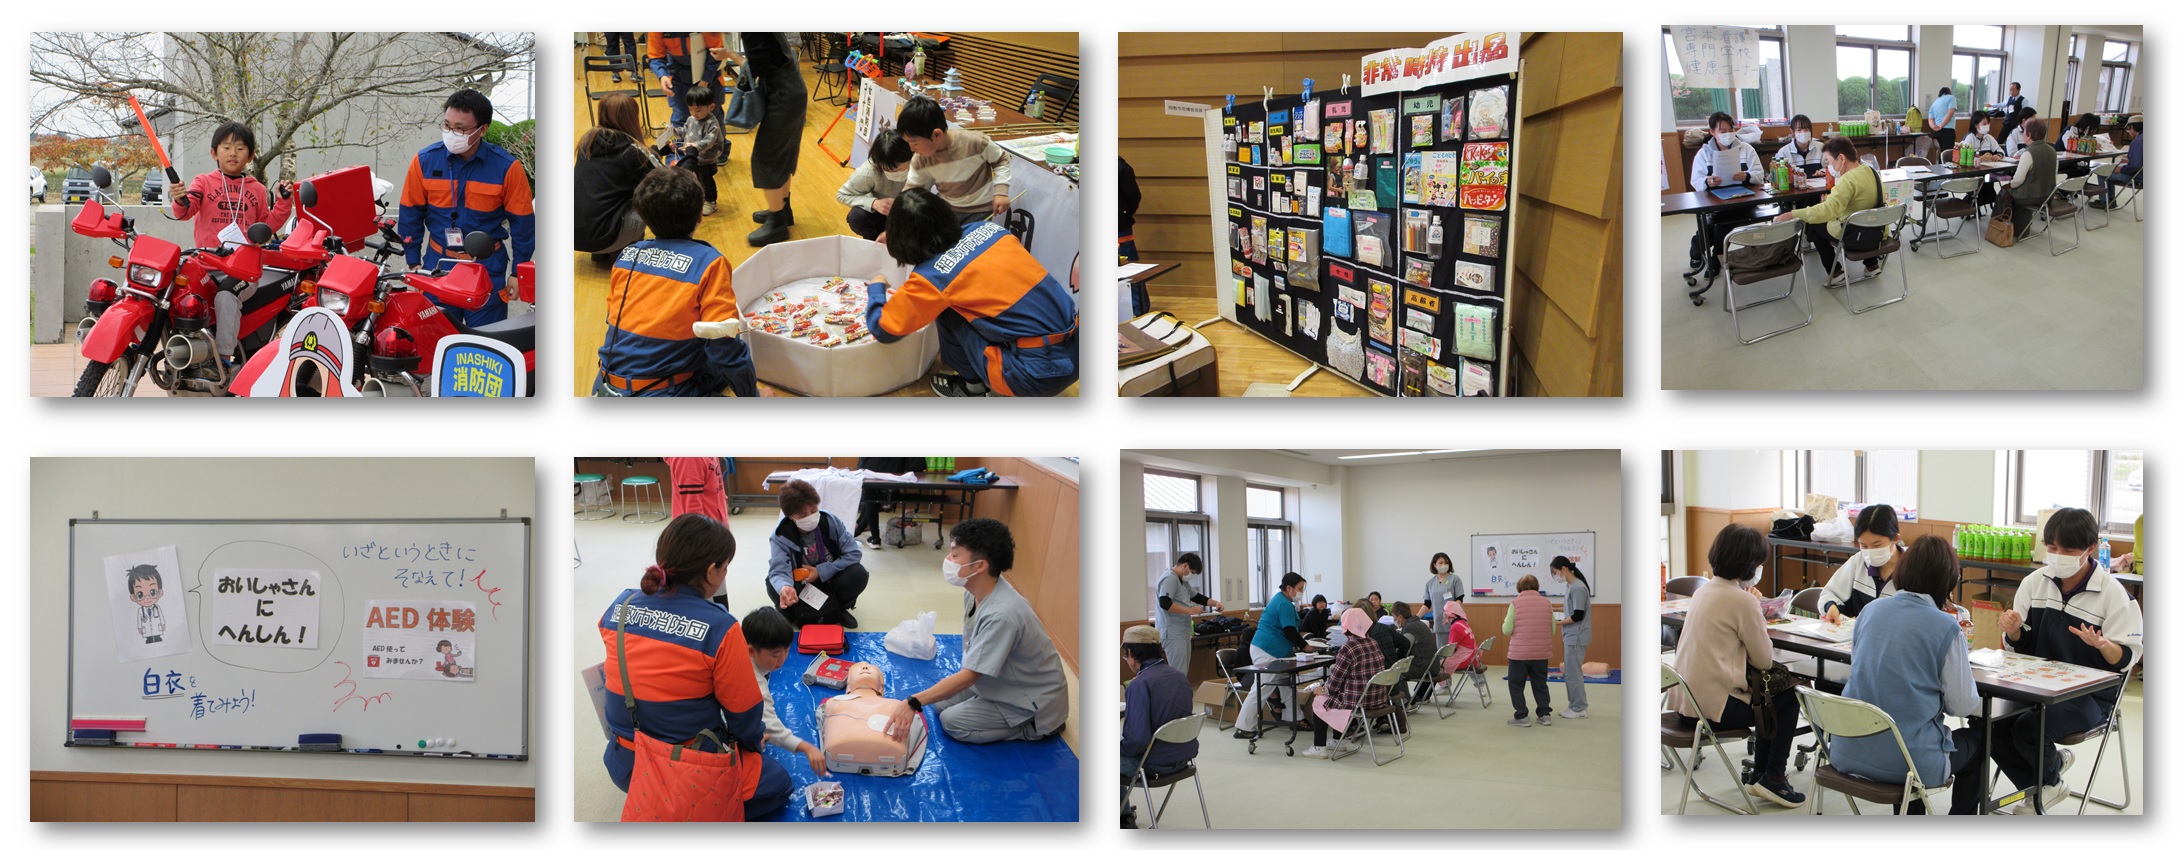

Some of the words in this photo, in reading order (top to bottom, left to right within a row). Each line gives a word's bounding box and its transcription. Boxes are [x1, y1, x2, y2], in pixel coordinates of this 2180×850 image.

[1681, 27, 1746, 44] 宮本看護
[1363, 32, 1508, 85] 非常時持出品
[1685, 43, 1752, 59] 専門学校
[1685, 59, 1758, 77] 健康コーナー
[1413, 99, 1434, 109] 幼児
[1464, 193, 1500, 206] ハッピーターン
[1411, 294, 1435, 308] 高齢者
[418, 306, 438, 320] YAMAHA
[456, 352, 503, 375] INASHIKI
[453, 366, 504, 397] 消防団
[342, 541, 477, 562] いざというときに
[218, 576, 315, 596] おいしゃさん
[256, 599, 274, 616] に
[366, 607, 420, 629] AED
[426, 607, 476, 633] 体験
[386, 645, 406, 653] 使って
